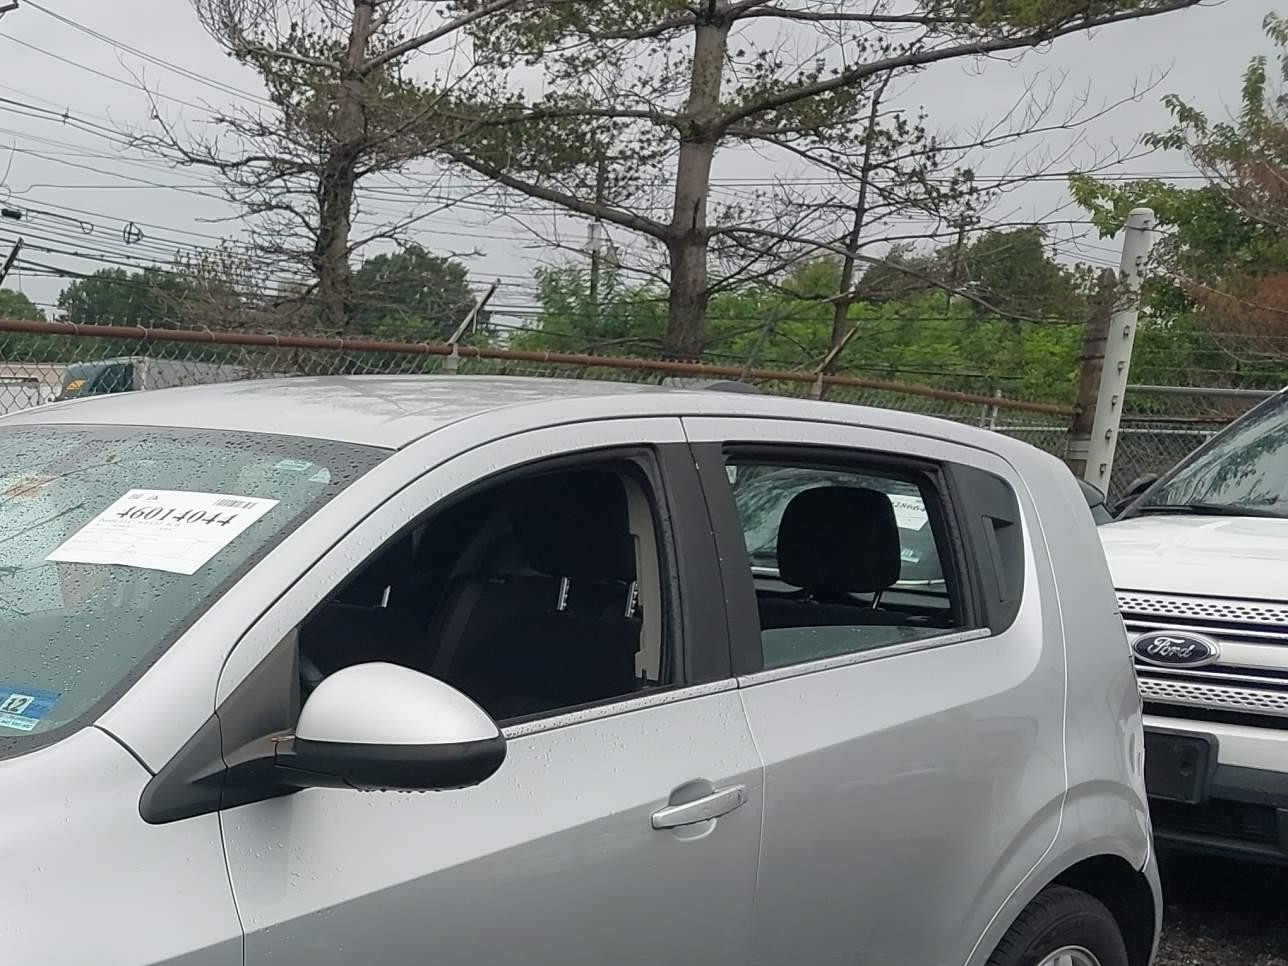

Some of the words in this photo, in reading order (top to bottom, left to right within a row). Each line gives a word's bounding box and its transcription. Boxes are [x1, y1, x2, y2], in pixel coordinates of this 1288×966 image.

[116, 505, 239, 527] 46014044
[1147, 636, 1196, 658] Ford
[1, 697, 28, 713] 12
